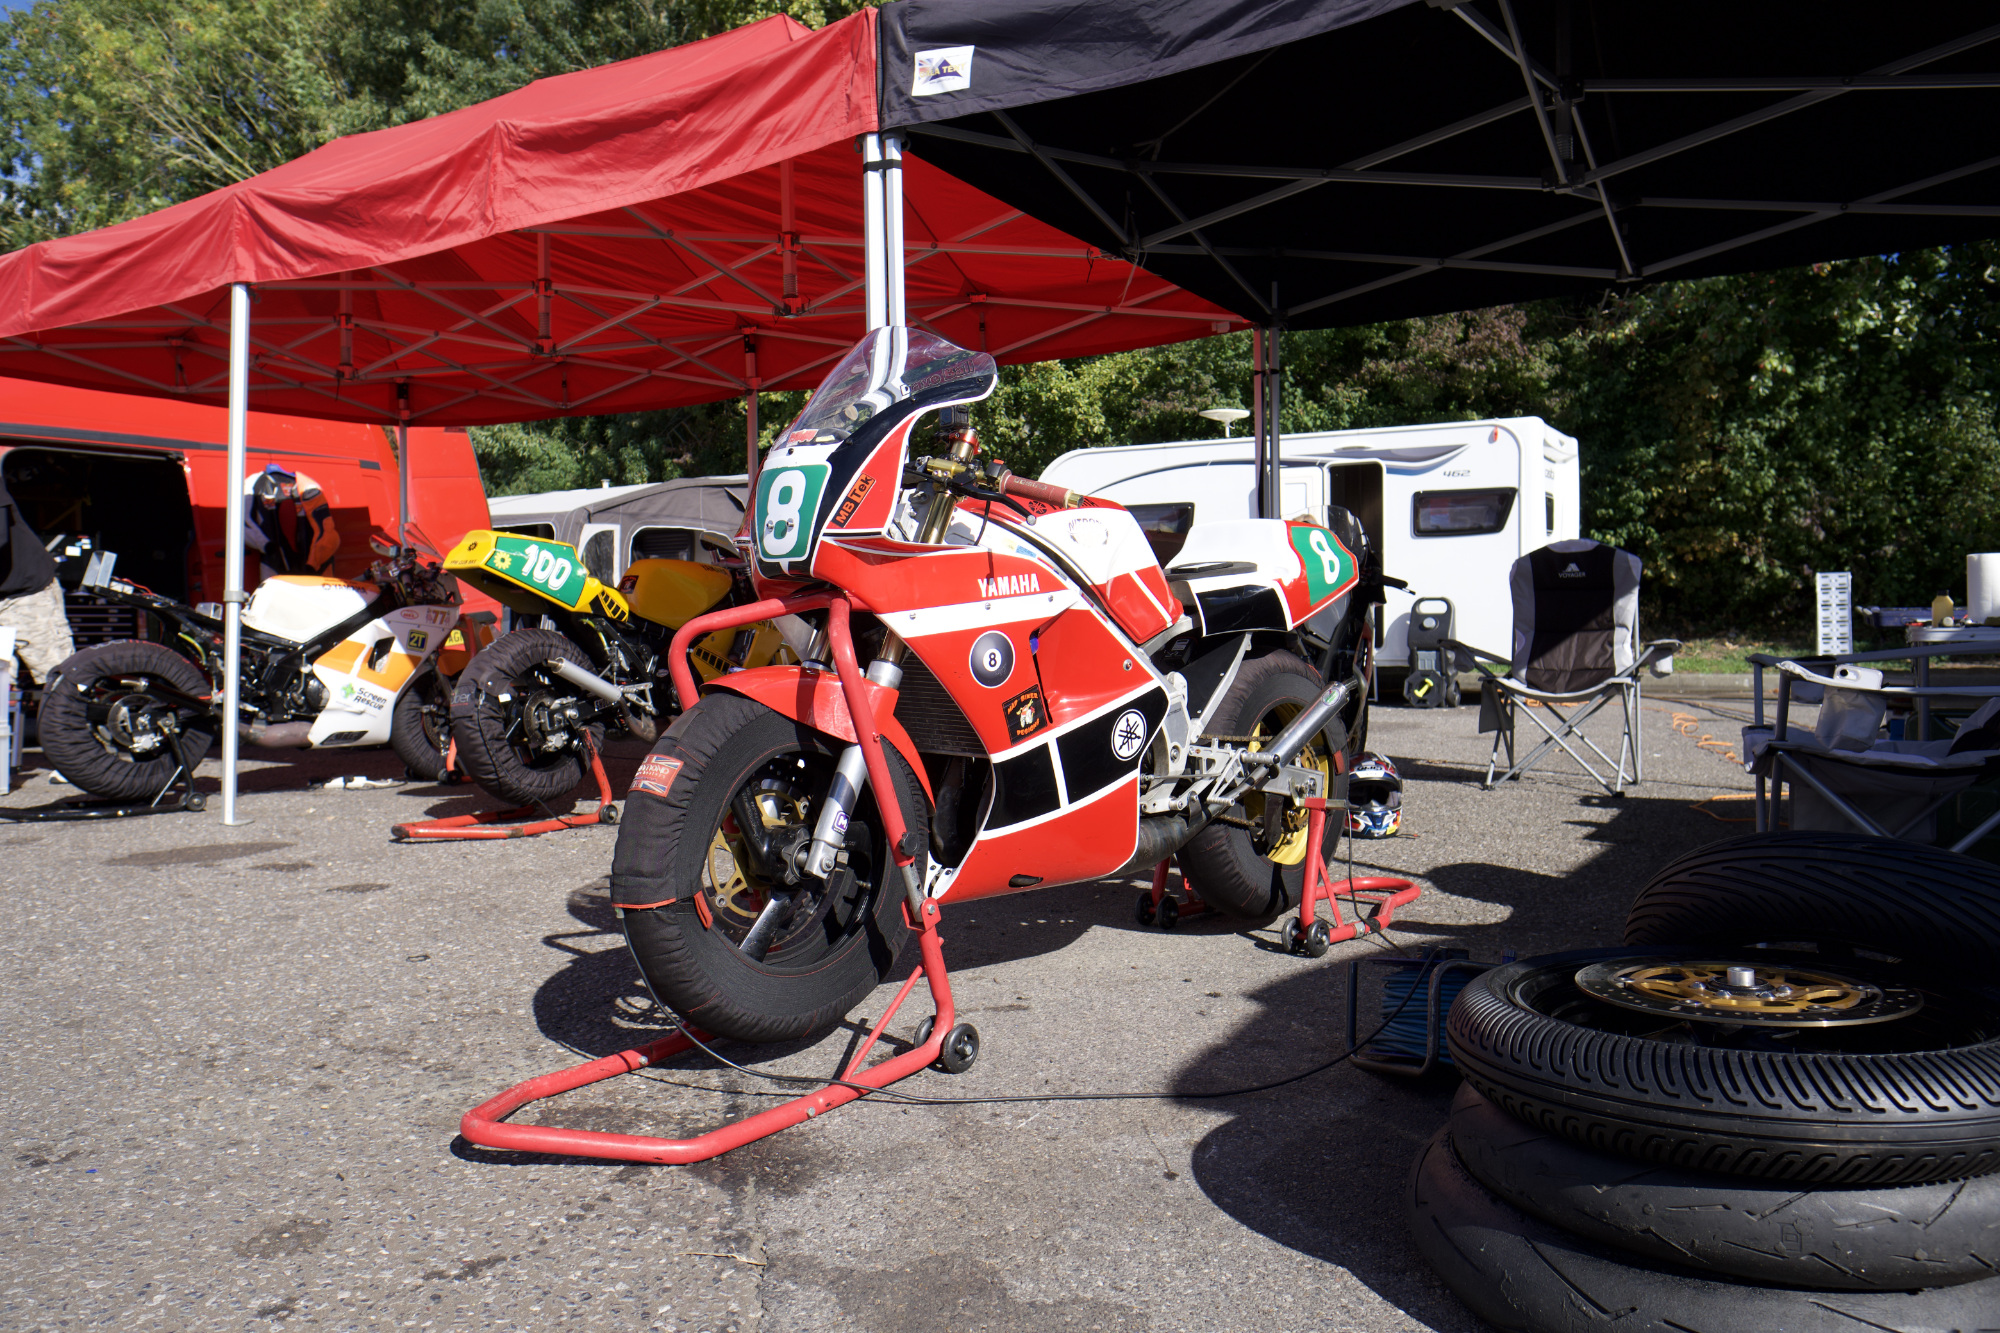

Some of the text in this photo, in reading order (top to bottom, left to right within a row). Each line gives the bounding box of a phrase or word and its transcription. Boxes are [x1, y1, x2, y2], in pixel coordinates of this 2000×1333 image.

[942, 63, 966, 74] TENT
[835, 475, 873, 524] MB Tek
[763, 470, 806, 555] 8
[1310, 530, 1340, 584] 8
[521, 544, 573, 591] 100
[977, 573, 1040, 598] YAMAHA
[432, 609, 447, 624] 77
[410, 634, 426, 647] 2T
[988, 652, 997, 668] 8
[353, 695, 385, 710] Rescue
[357, 687, 387, 704] Screen
